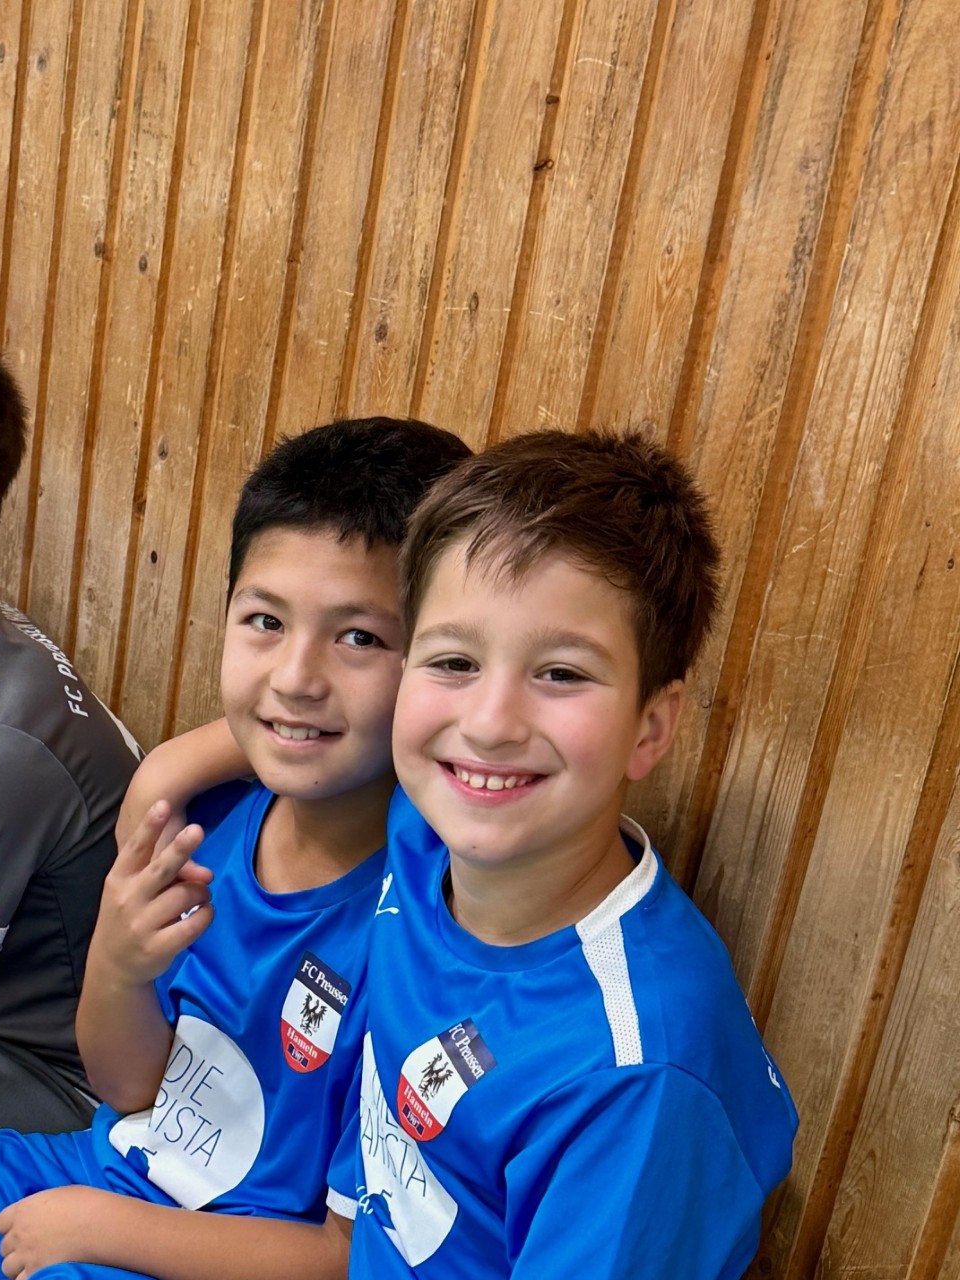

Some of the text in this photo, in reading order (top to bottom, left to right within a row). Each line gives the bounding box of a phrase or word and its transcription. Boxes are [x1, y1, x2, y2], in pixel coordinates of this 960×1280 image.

[64, 685, 89, 718] FC
[301, 960, 319, 980] FC
[286, 1026, 319, 1059] Hameln
[455, 1035, 486, 1080] Preussen
[164, 1043, 224, 1107] DIE
[148, 1086, 223, 1168] RISTA
[403, 1085, 434, 1129] Hameln
